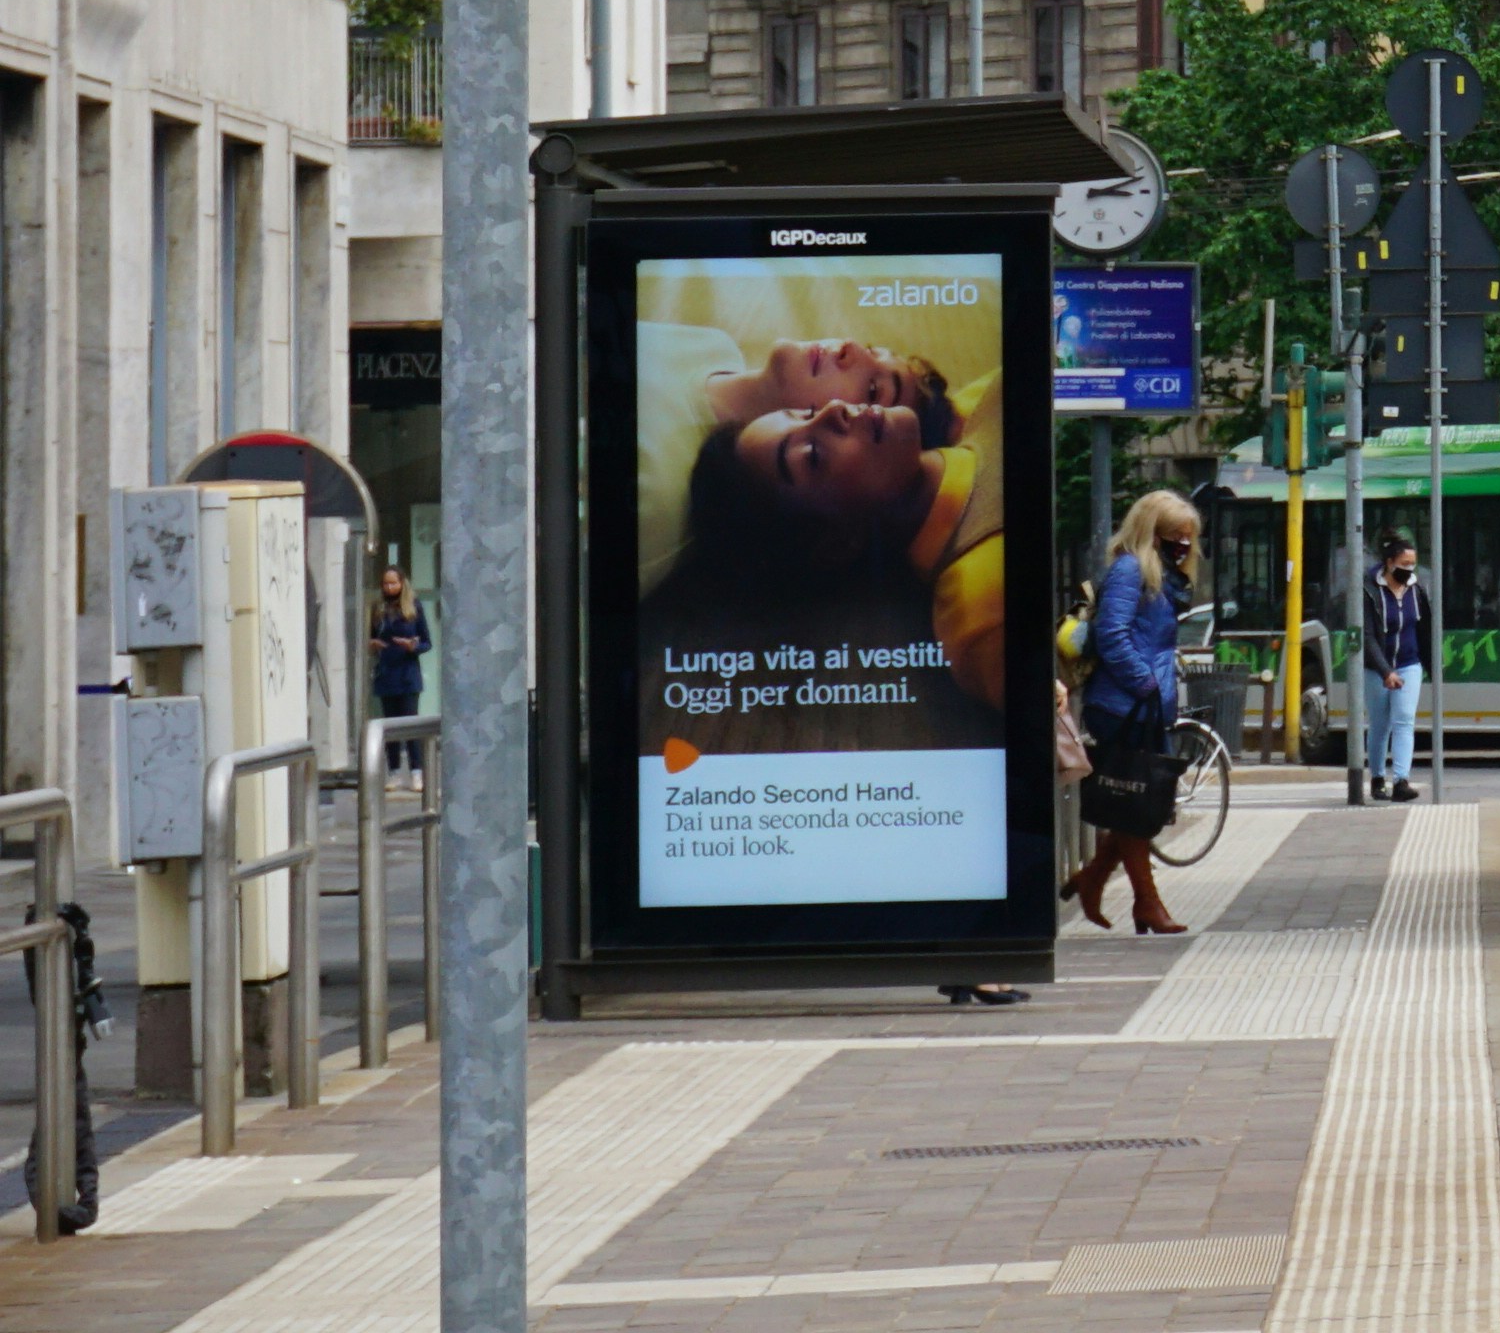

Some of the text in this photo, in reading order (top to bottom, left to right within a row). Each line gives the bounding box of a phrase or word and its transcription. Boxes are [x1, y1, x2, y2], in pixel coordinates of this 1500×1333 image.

[771, 229, 867, 246] IGPDecaux
[858, 279, 979, 307] zalando
[1066, 281, 1095, 290] Centro
[1150, 279, 1185, 290] Italiano
[358, 353, 441, 379] PIACENZ
[1150, 378, 1181, 393] CDI
[664, 641, 952, 678] Lunga vita ai vestiti.
[664, 676, 917, 715] Oggi per domani.
[665, 781, 921, 806] Zalando Second Hand.
[665, 806, 964, 832] Dai una seconda occasione
[665, 834, 795, 858] ai tuoi look.
